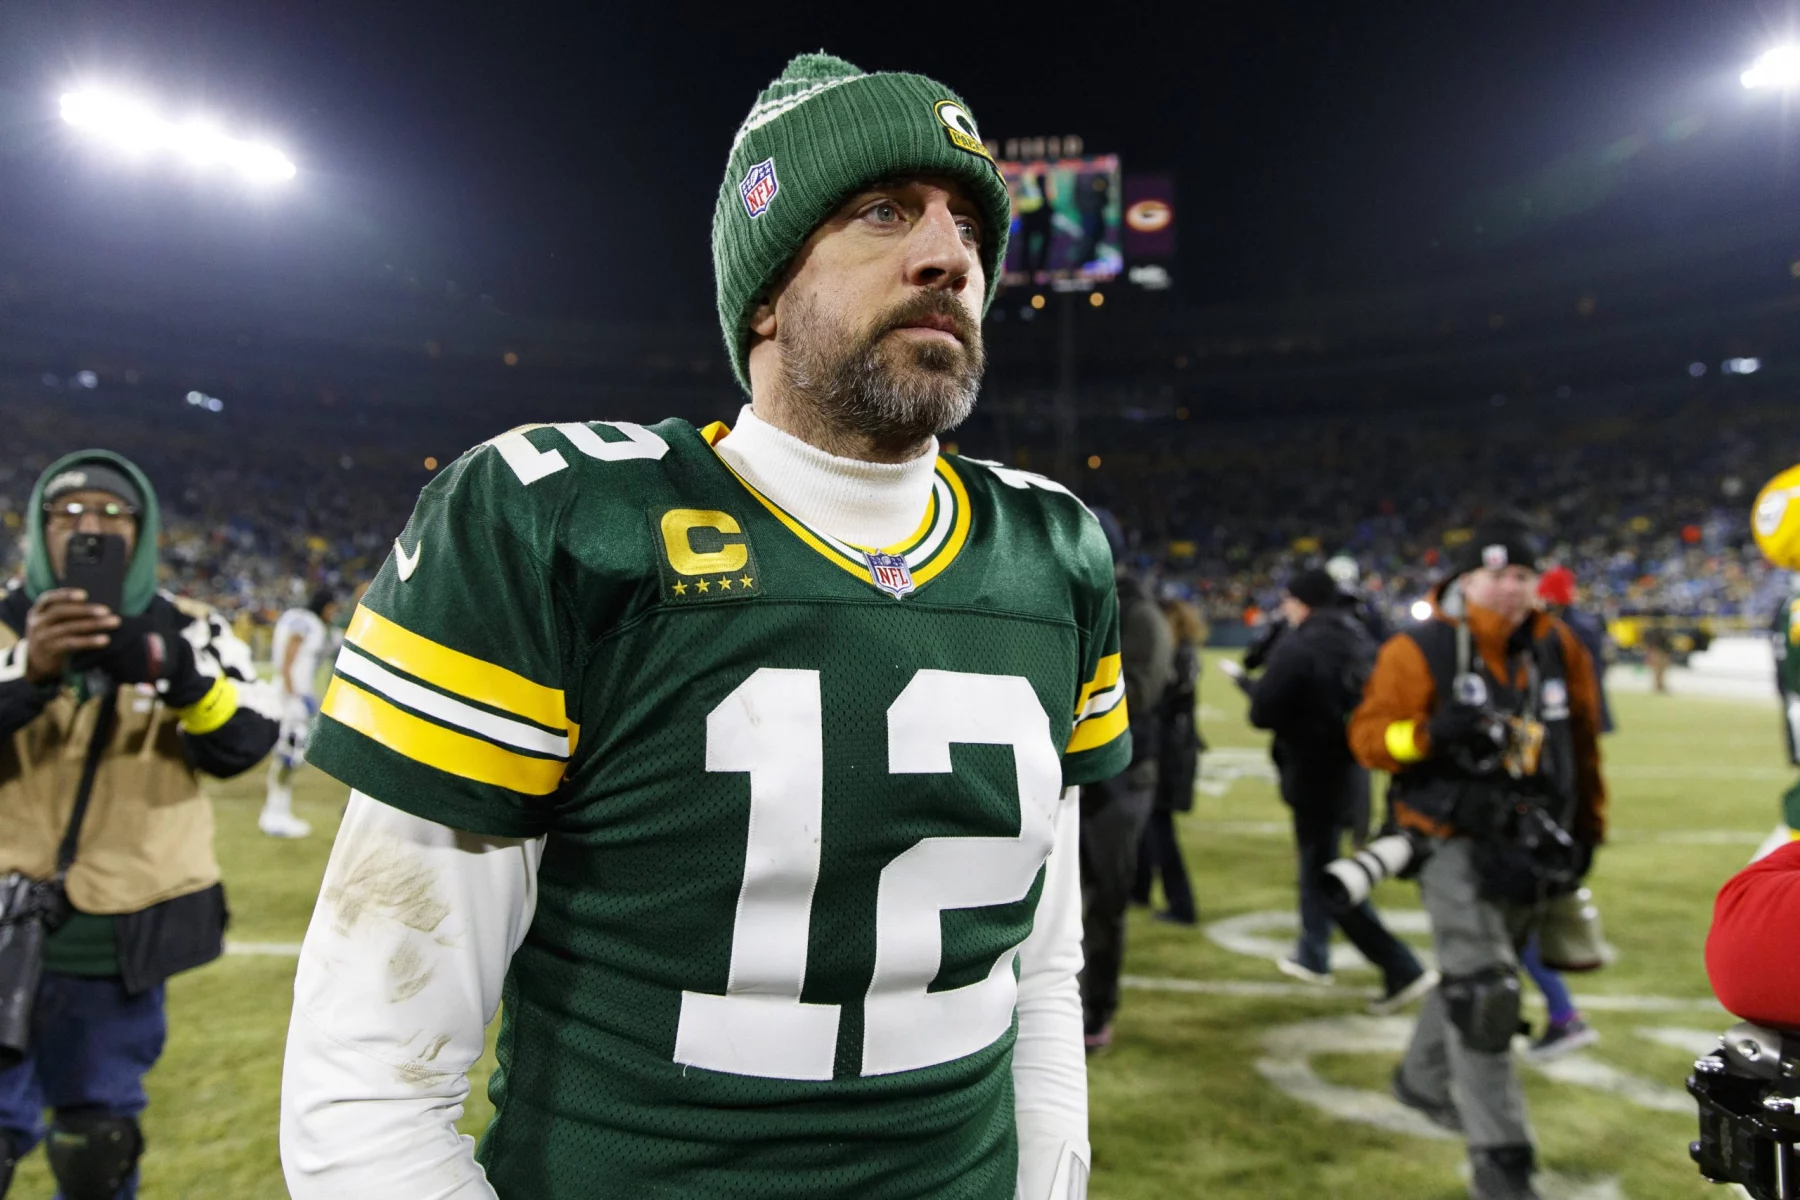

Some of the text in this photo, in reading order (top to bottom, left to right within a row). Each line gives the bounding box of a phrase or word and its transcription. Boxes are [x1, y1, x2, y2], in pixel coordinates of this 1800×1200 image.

[747, 178, 774, 213] NFL
[661, 508, 748, 576] C
[877, 567, 909, 588] NFL
[673, 667, 1062, 1080] 12
